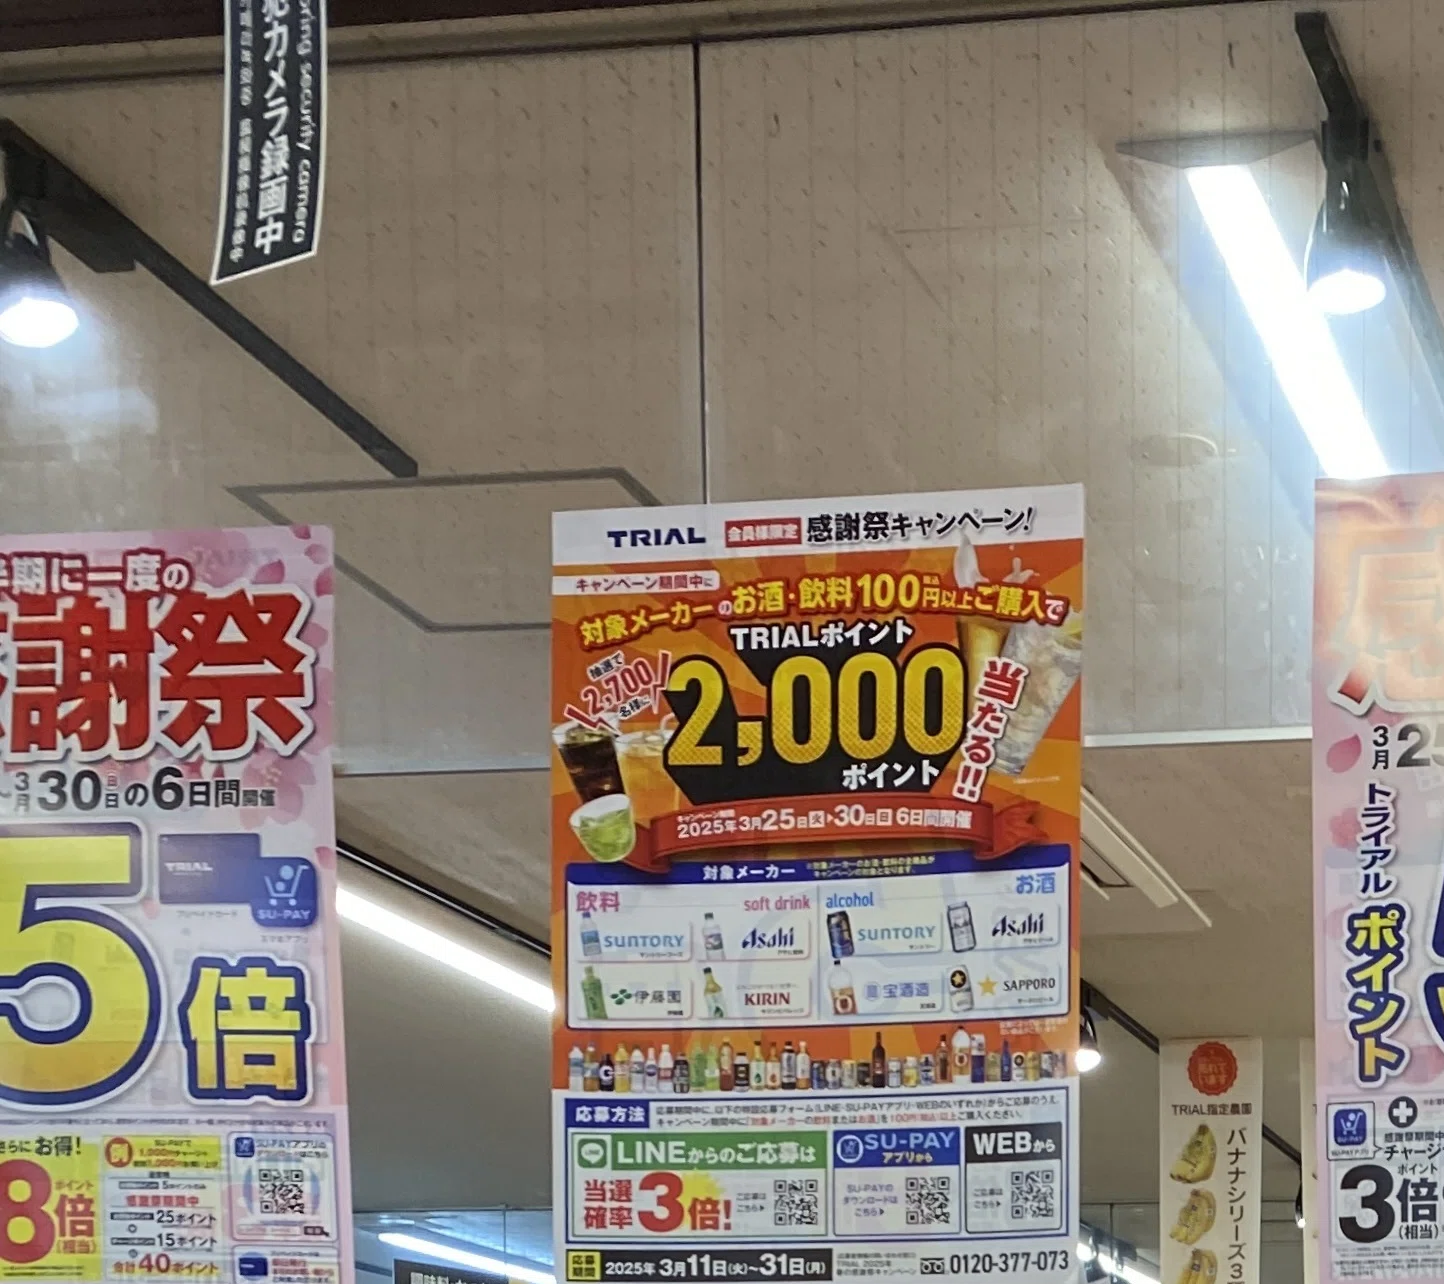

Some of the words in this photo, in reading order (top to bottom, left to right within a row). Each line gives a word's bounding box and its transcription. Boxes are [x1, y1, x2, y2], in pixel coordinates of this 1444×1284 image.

[293, 159, 311, 243] camera
[607, 528, 707, 547] TRIAL
[730, 619, 914, 650] TRIALポイント
[666, 648, 965, 767] 2,000
[842, 757, 940, 789] ポイント
[165, 861, 213, 874] TRIAL
[702, 864, 796, 881] 対象メーカー
[1016, 873, 1056, 894] お酒
[575, 891, 621, 913] 飲料
[744, 895, 772, 911] soft
[776, 893, 811, 910] drink
[825, 892, 874, 908] alcohol
[258, 908, 312, 920] SU-PAY
[858, 924, 936, 942] SUNTORY
[992, 912, 1045, 938] Asahi
[603, 932, 684, 949] SUNTORY
[742, 926, 795, 949] Asahi
[1002, 976, 1056, 991] SAPPORO
[744, 991, 791, 1007] KIRIN
[180, 961, 315, 1103] 倍
[575, 1107, 645, 1123] 応募方法
[616, 1134, 816, 1165] LINEからのご応募は
[864, 1131, 955, 1152] SU-PAY
[974, 1132, 1056, 1155] WEBから
[1398, 1164, 1438, 1175] ポイント
[584, 1180, 632, 1204] 当選
[0, 1159, 55, 1264] 8
[584, 1206, 632, 1230] 確率
[950, 1250, 1069, 1274] 0120-377-073
